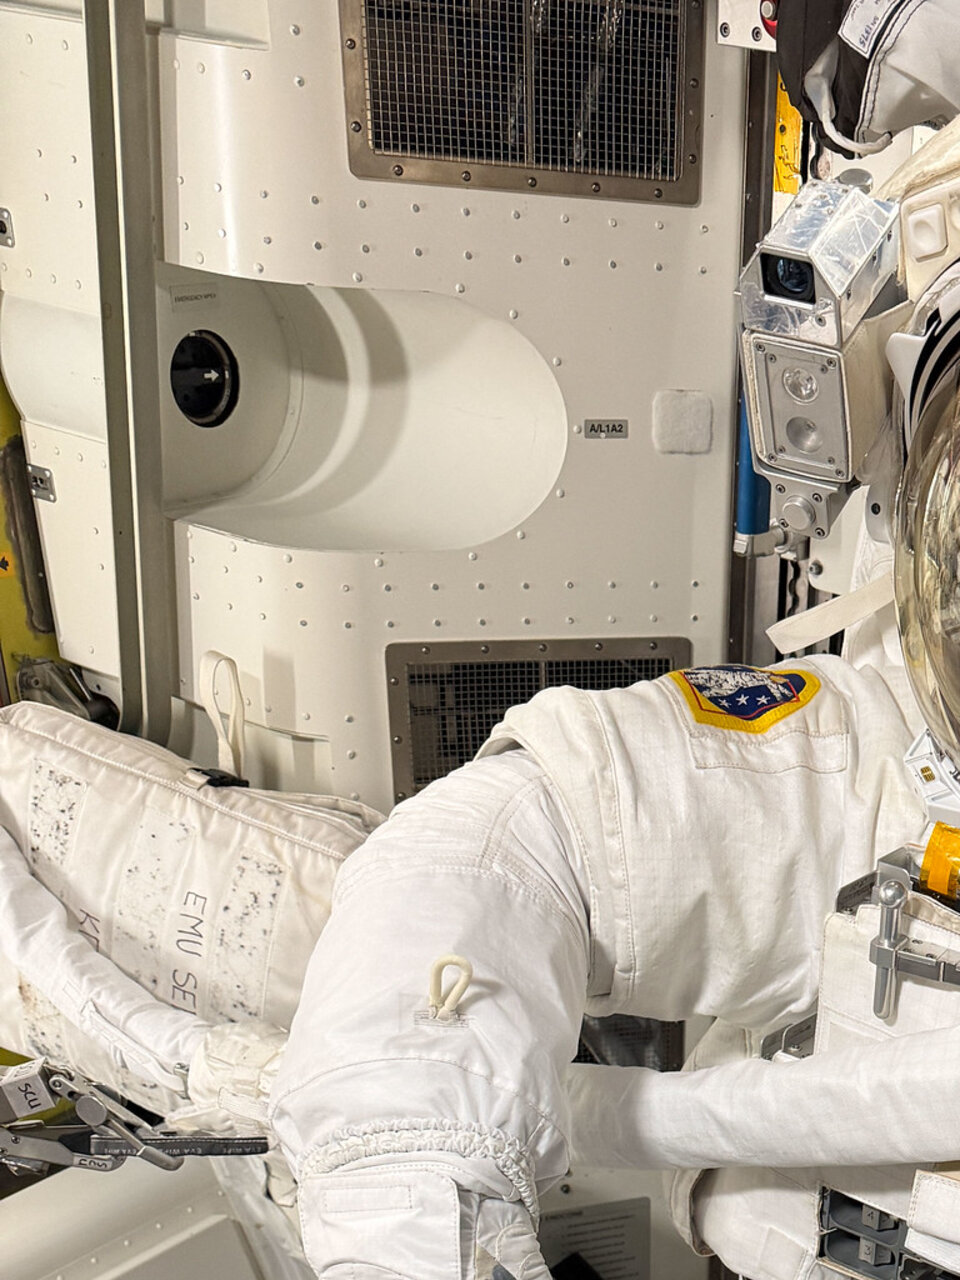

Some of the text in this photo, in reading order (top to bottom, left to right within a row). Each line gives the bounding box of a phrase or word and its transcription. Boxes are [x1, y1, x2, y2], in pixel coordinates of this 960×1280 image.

[589, 423, 624, 433] A/L1A2
[171, 891, 208, 1016] EMU SE
[17, 1082, 42, 1110] SCU
[79, 1158, 108, 1169] SCU
